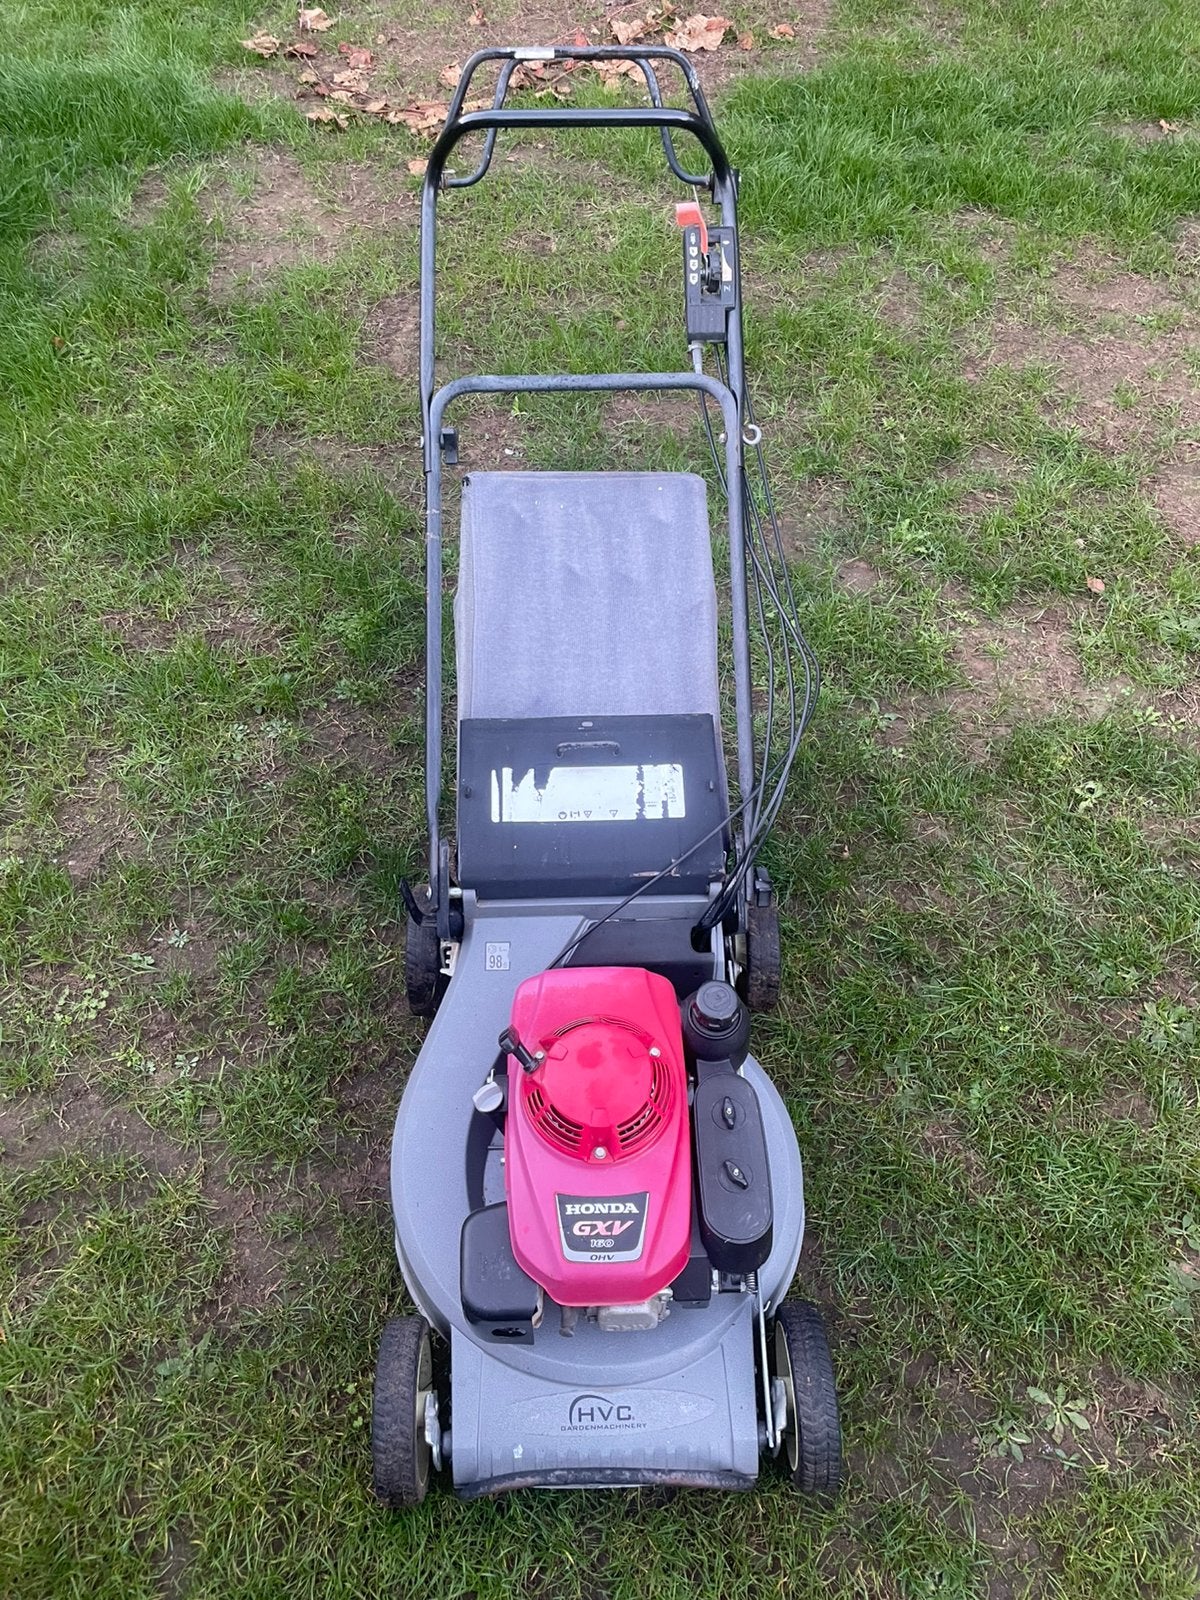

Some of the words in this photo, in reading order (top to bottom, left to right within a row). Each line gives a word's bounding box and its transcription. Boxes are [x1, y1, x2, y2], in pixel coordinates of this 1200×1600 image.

[489, 954, 503, 969] 98
[565, 1202, 640, 1215] HONDA
[572, 1220, 635, 1236] GXV
[590, 1238, 615, 1248] 160
[589, 1253, 615, 1261] OHV
[577, 1405, 632, 1423] HVC
[560, 1422, 648, 1432] GARDENMACHINERY
